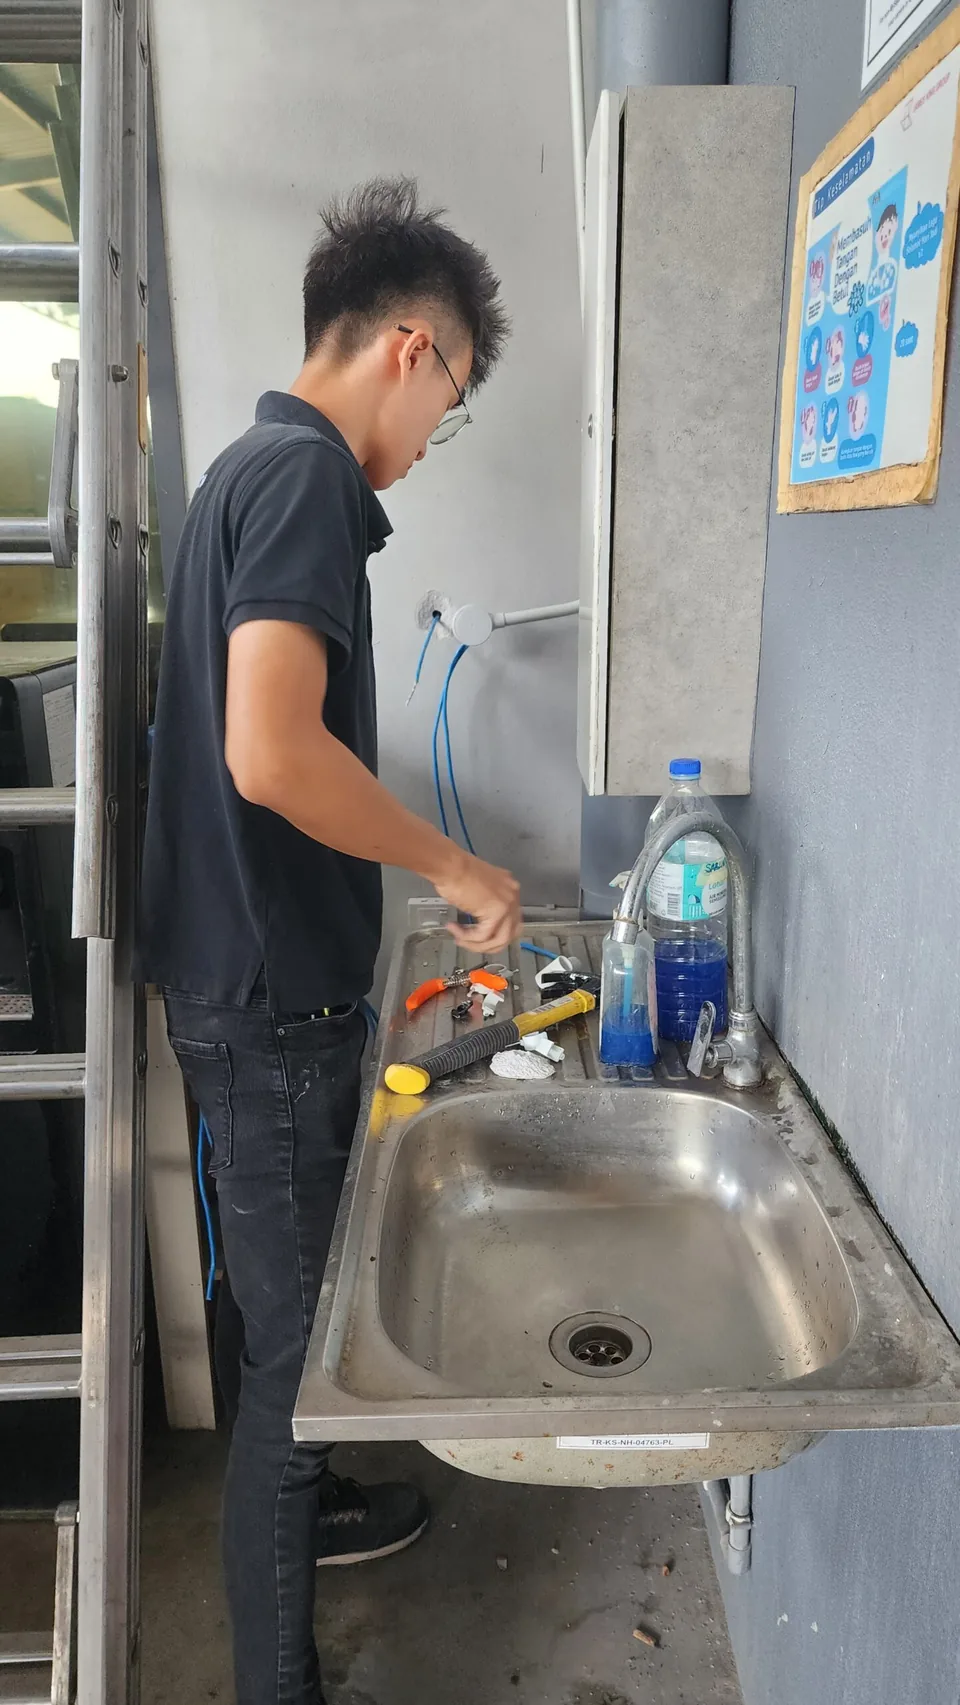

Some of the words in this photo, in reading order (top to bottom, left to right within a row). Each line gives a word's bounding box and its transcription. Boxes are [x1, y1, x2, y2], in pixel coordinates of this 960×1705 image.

[827, 151, 871, 200] Keselamatan
[837, 216, 872, 251] Membasuh
[836, 246, 858, 270] Tangan
[834, 263, 858, 288] Dengan
[832, 281, 849, 306] Betul
[591, 1438, 674, 1446] TR-KS-NH-04763-PL
